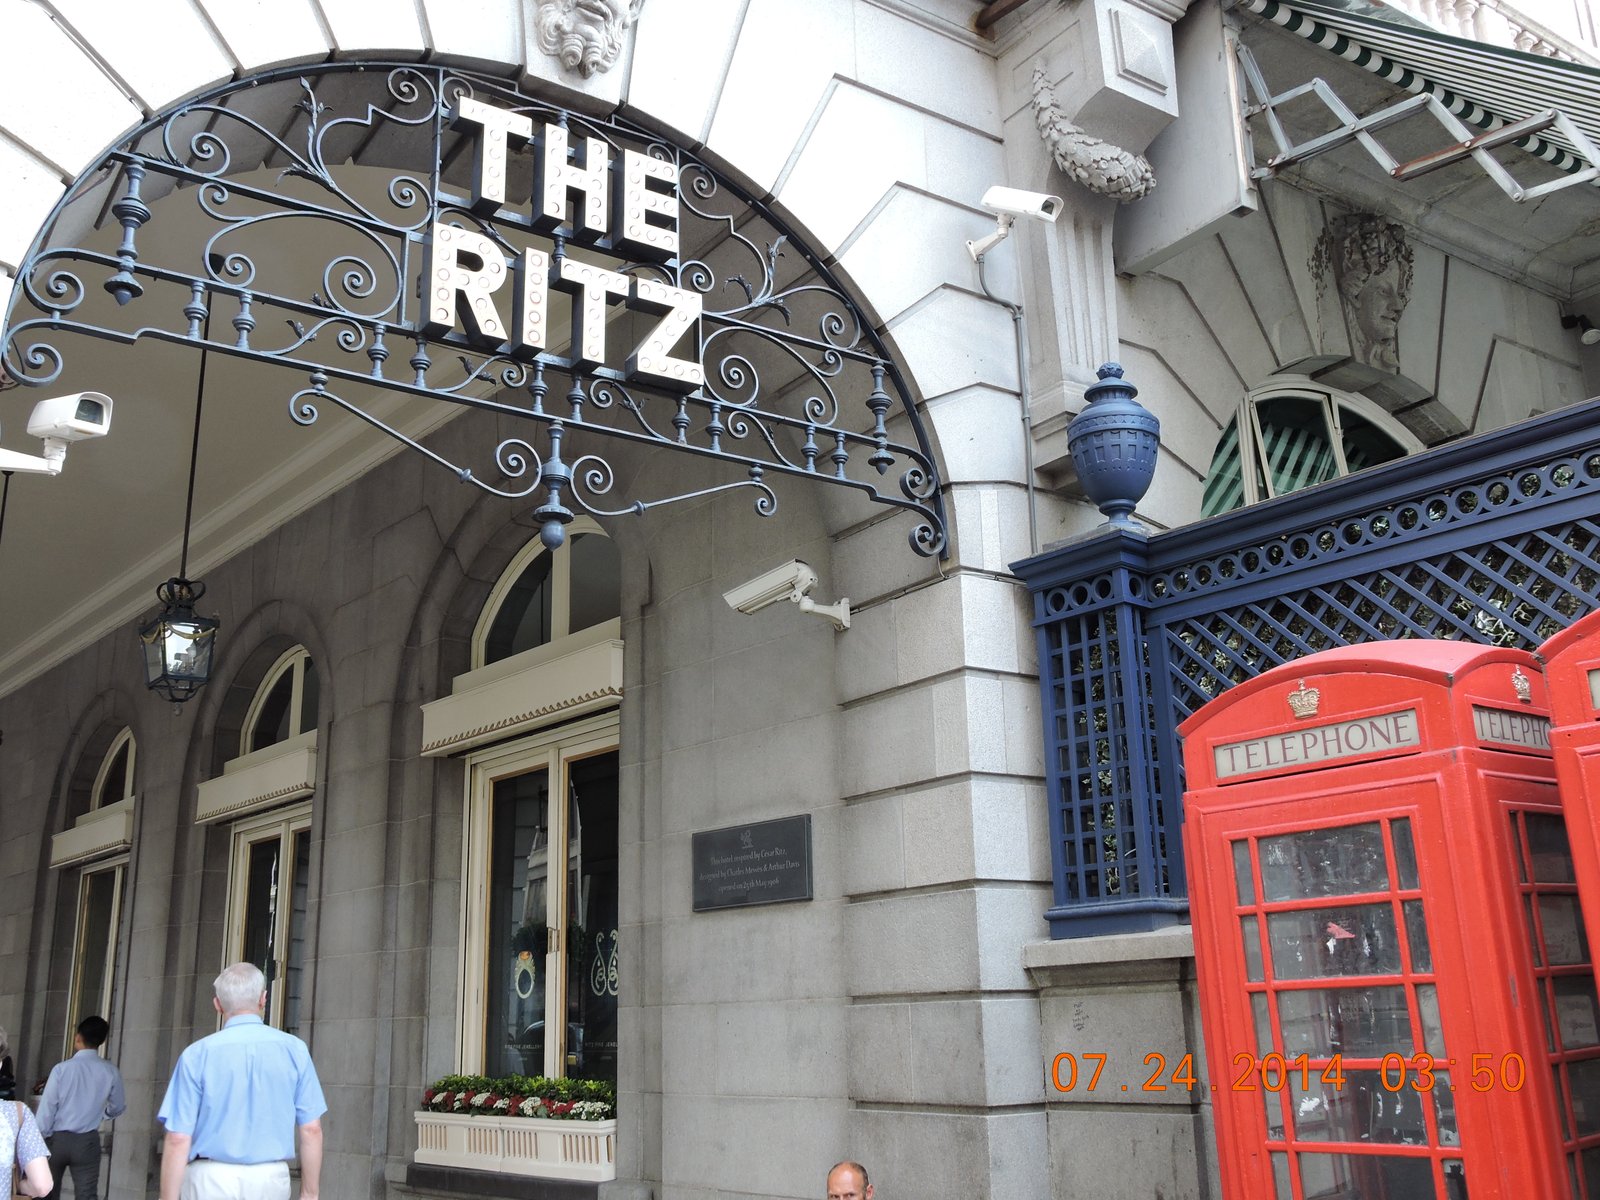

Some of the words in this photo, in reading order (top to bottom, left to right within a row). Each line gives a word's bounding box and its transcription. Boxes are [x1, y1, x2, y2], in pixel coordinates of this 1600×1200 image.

[454, 95, 677, 255] THE
[426, 221, 705, 387] RITZ
[1222, 713, 1413, 773] TELEPHONE
